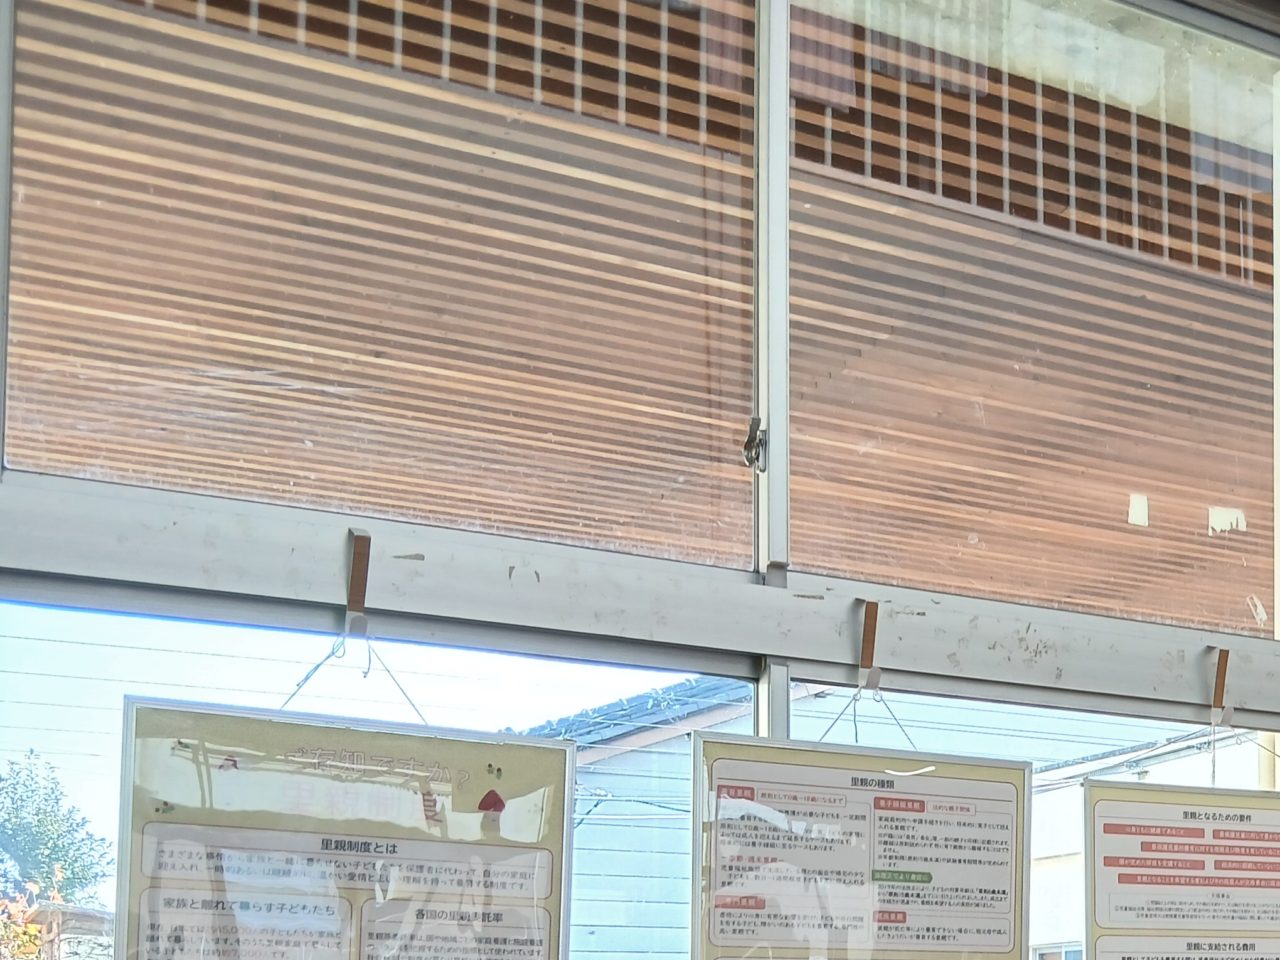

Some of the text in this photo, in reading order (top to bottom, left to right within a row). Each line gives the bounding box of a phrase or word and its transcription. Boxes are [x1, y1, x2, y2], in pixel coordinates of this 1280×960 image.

[850, 777, 895, 789] 里親の種類
[1182, 811, 1252, 822] 里親となるための要件
[321, 837, 398, 855] 里親制度とは
[1186, 942, 1256, 952] 里親に支給される費用
